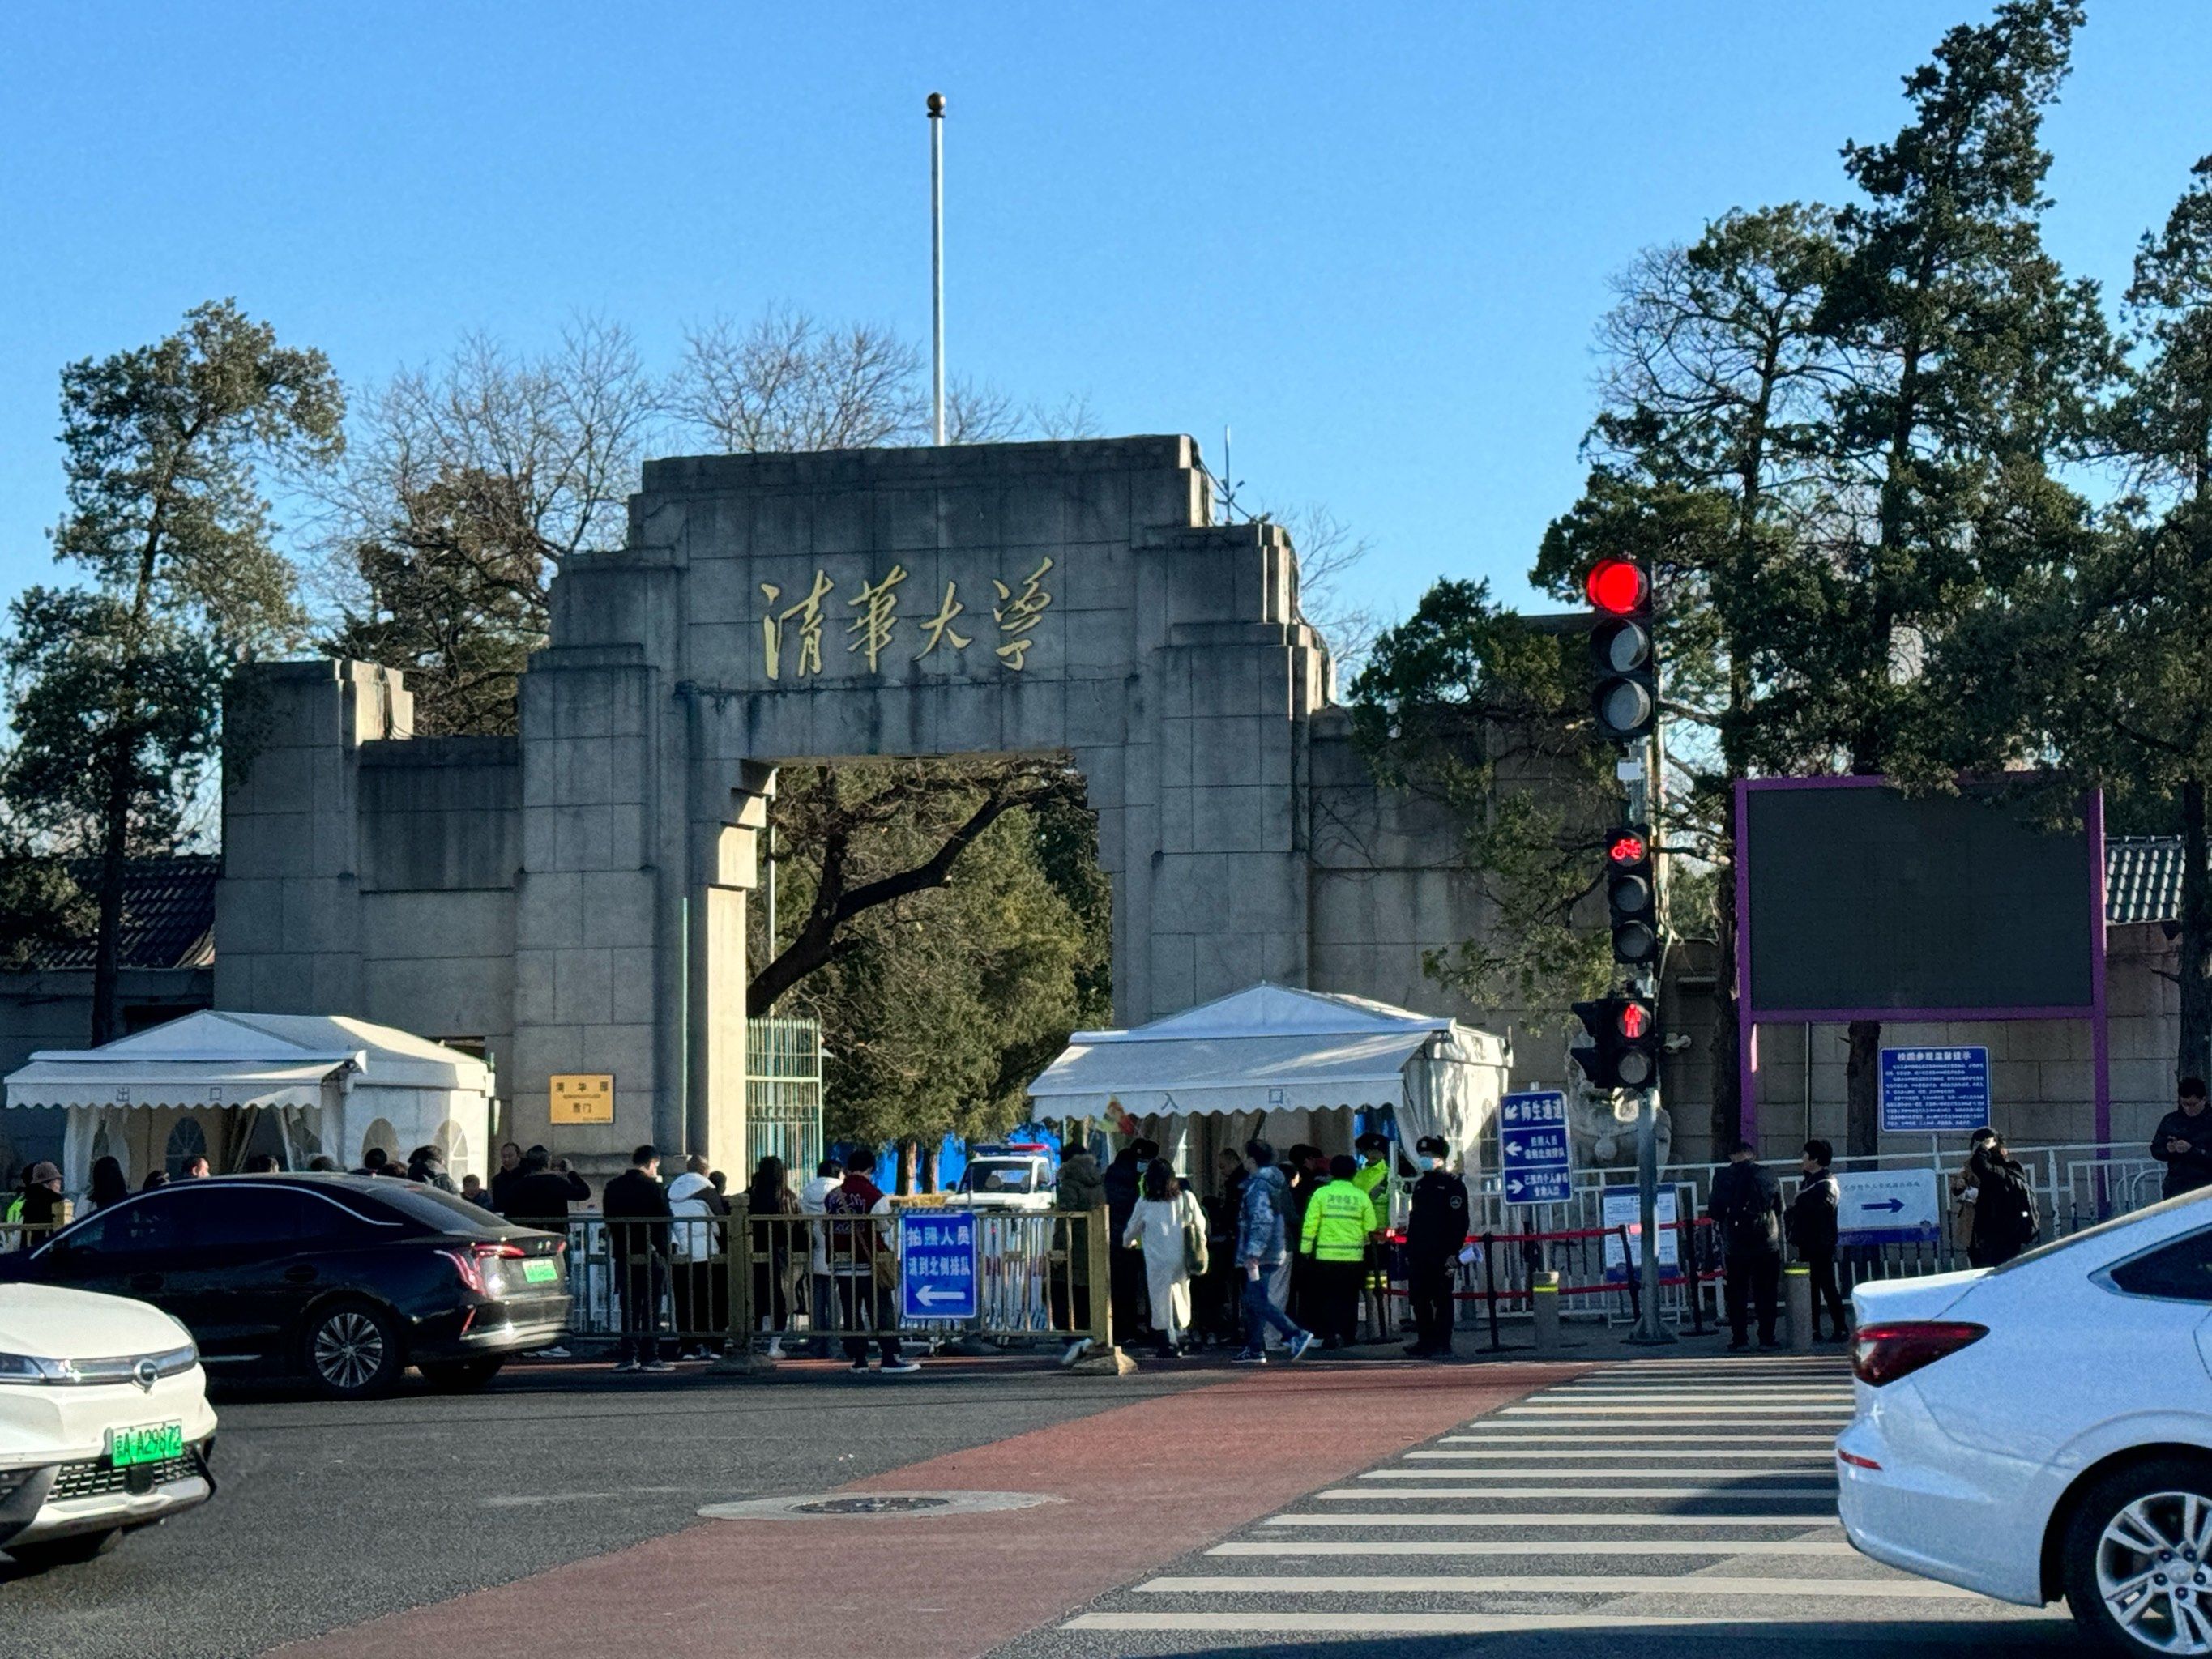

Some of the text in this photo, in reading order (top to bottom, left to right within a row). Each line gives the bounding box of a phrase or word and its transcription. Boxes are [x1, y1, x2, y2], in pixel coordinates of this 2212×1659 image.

[1160, 1089, 1283, 1110] 入口
[1521, 1098, 1563, 1121] 师生通道
[907, 1226, 971, 1247] 拍照人员
[908, 1256, 971, 1277] 请到北侧排队
